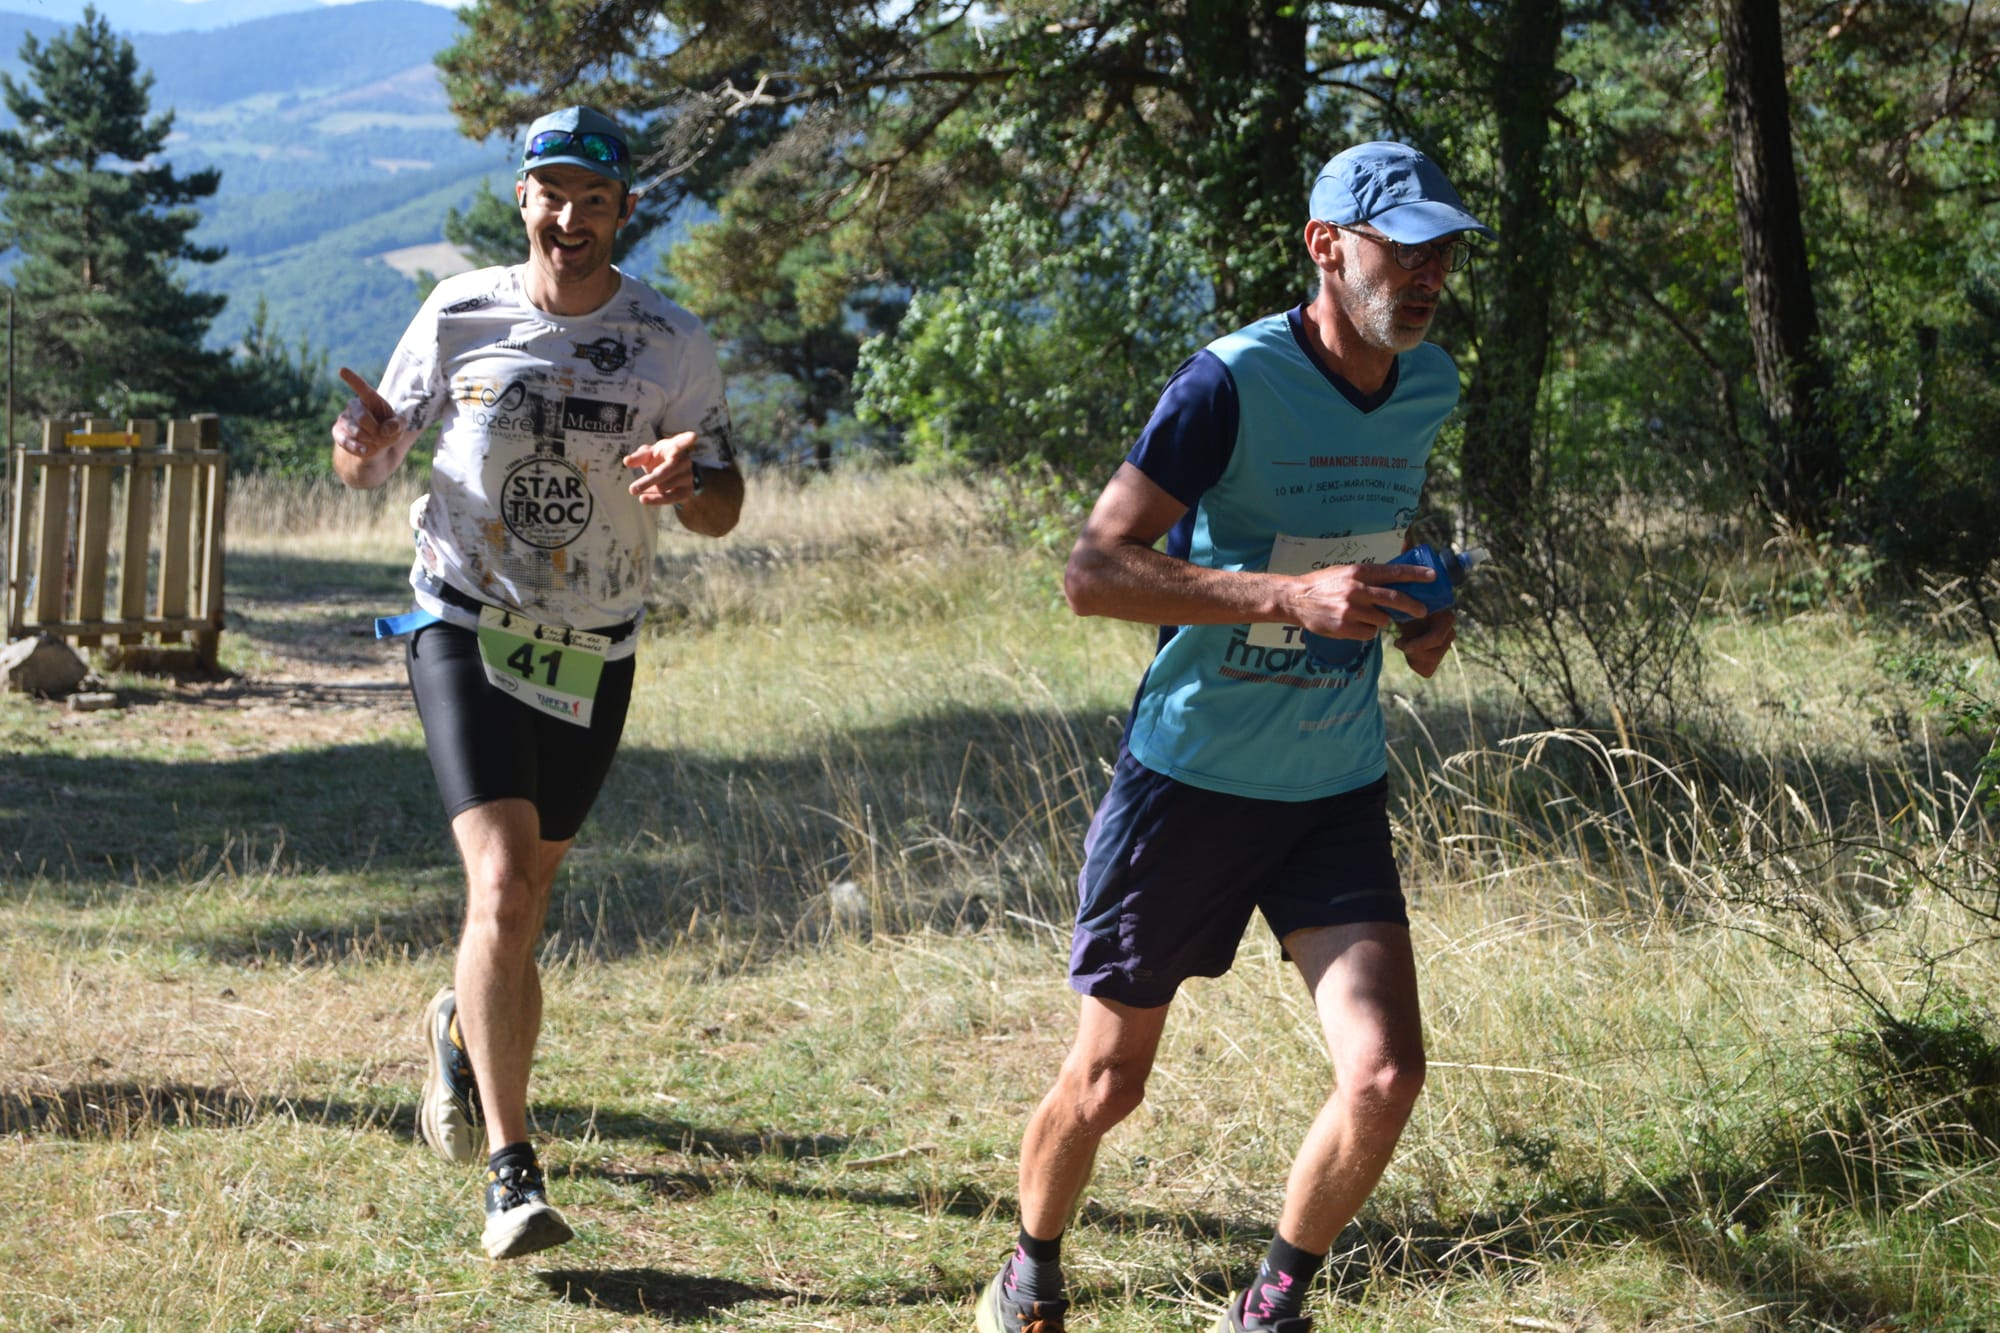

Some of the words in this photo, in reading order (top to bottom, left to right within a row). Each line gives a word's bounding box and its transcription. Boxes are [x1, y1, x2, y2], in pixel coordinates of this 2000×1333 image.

[472, 408, 533, 432] lozère
[567, 412, 622, 433] Mende
[1309, 456, 1358, 468] DIMANCHE
[1359, 456, 1370, 467] 30
[1371, 456, 1390, 468] AVRIL
[1391, 457, 1408, 469] 2017
[512, 475, 583, 499] STAR
[1275, 487, 1286, 497] 10
[1290, 485, 1304, 495] KM
[1315, 478, 1386, 492] SEMI-MARATHON
[508, 500, 585, 524] TROC
[507, 642, 563, 687] 41
